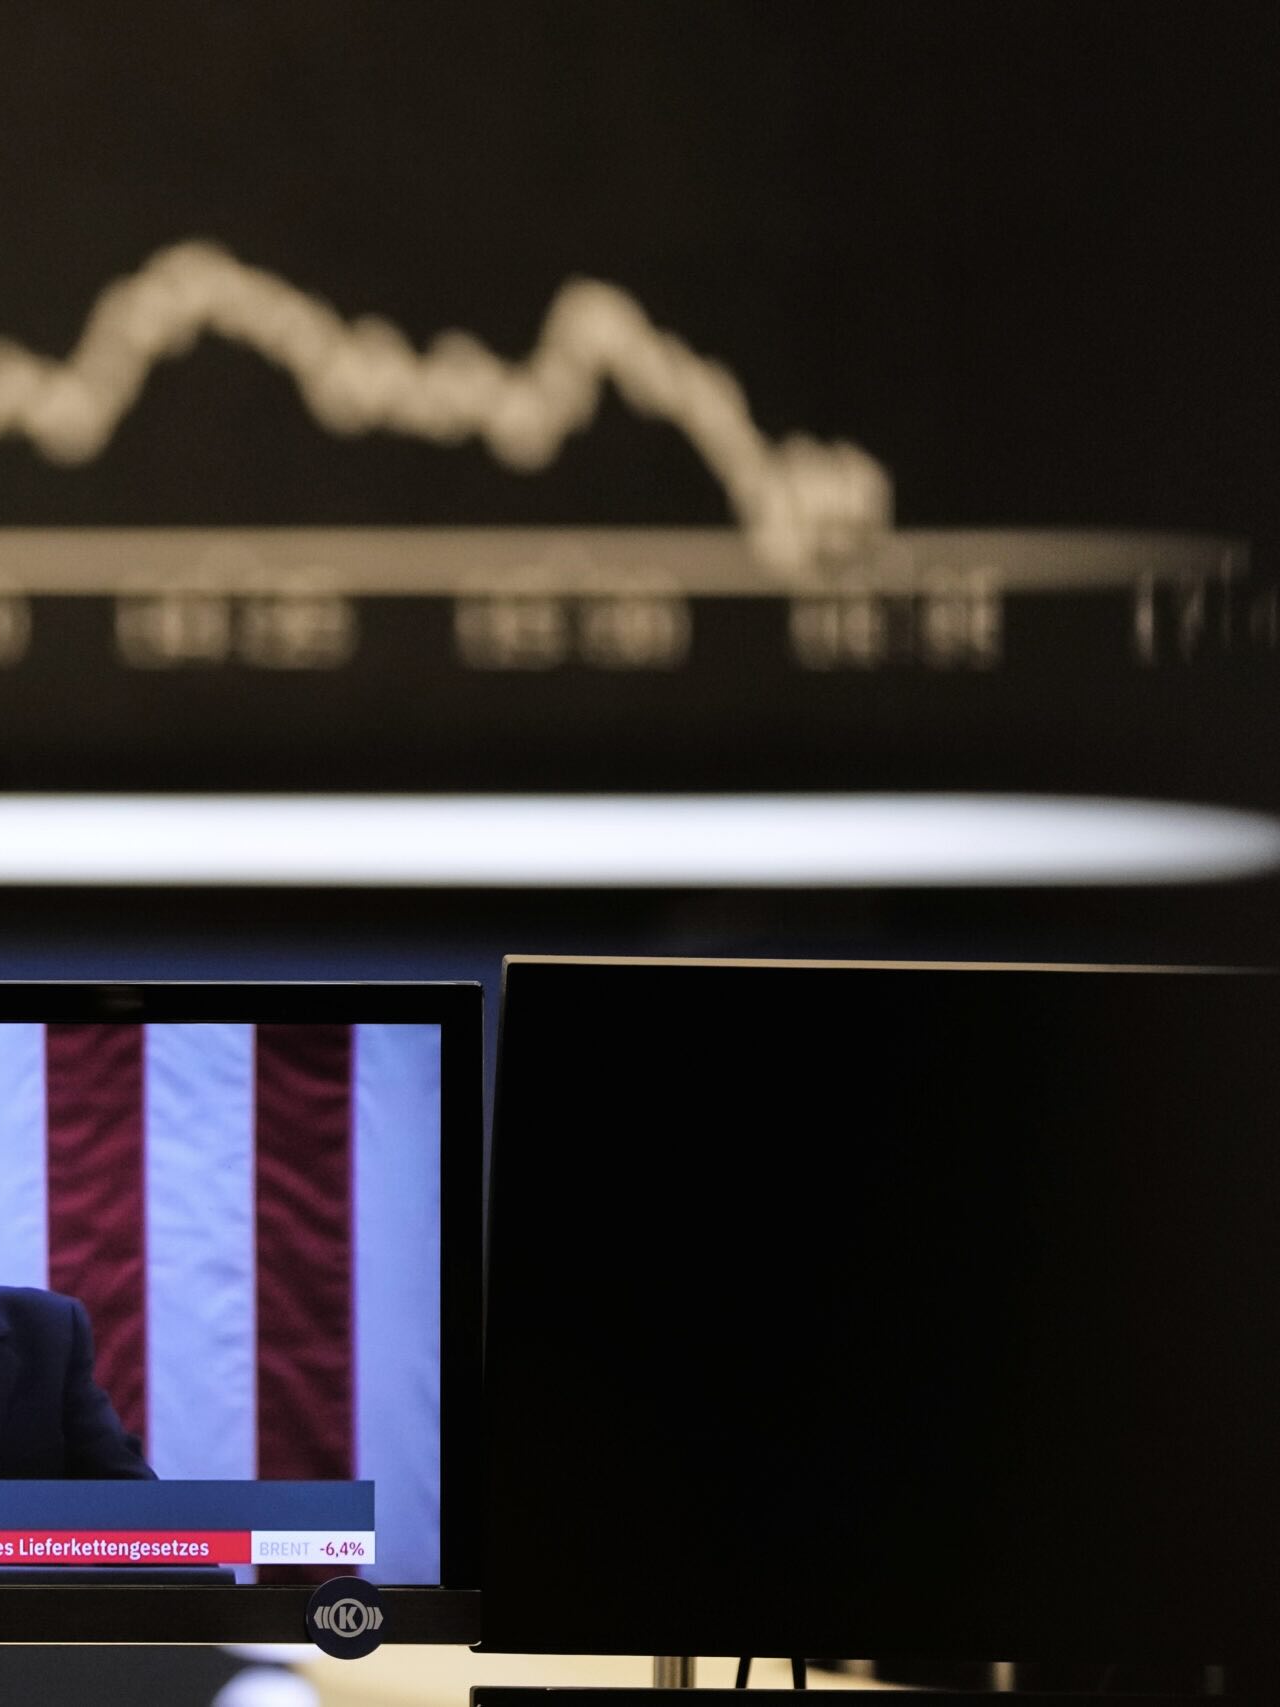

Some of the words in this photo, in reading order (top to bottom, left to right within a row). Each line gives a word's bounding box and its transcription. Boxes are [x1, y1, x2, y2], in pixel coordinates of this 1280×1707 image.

[20, 1538, 209, 1560] Lieferkettengesetzes
[259, 1542, 310, 1556] BRENT
[320, 1542, 365, 1558] -6,4%
[338, 1606, 358, 1630] K
